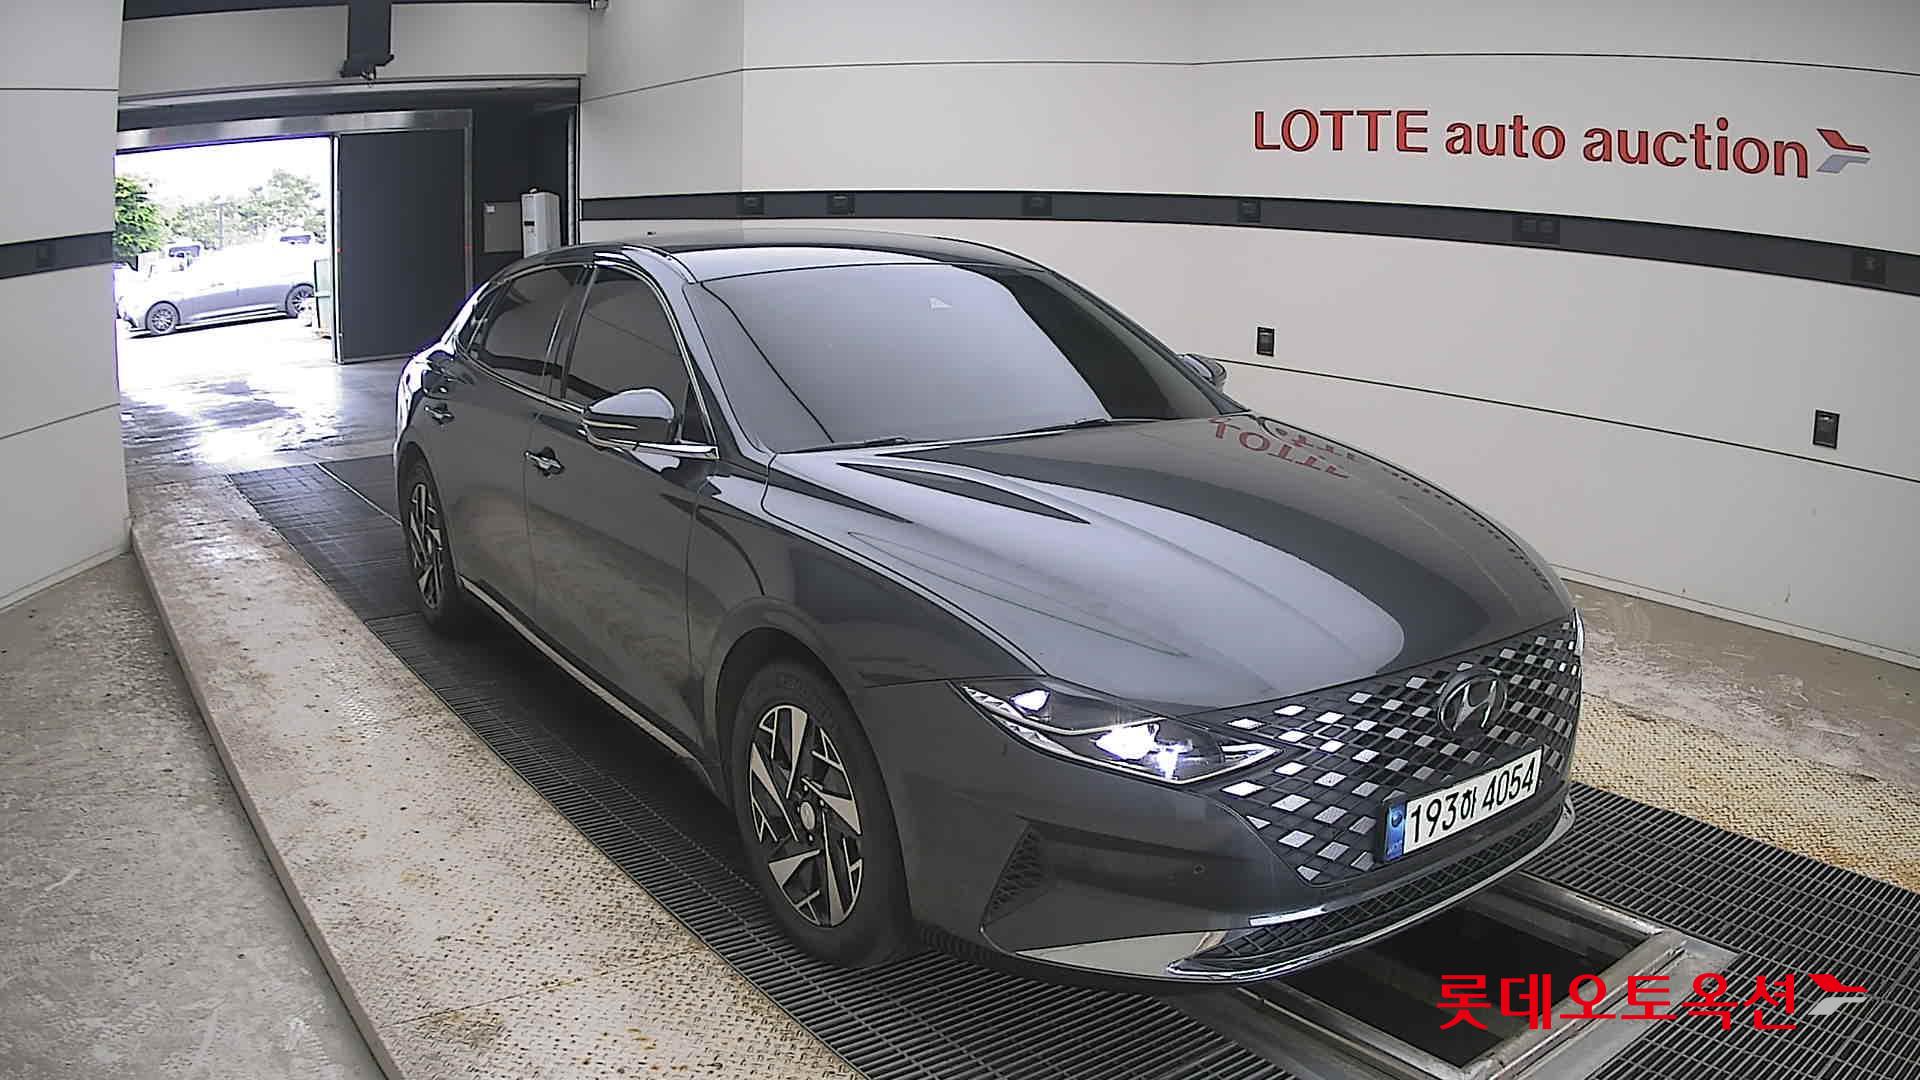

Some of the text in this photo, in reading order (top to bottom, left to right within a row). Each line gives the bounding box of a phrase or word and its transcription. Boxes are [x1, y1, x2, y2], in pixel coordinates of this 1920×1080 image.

[1254, 109, 1810, 179] LOTTE auto auction
[1410, 757, 1537, 843] 193하 4054
